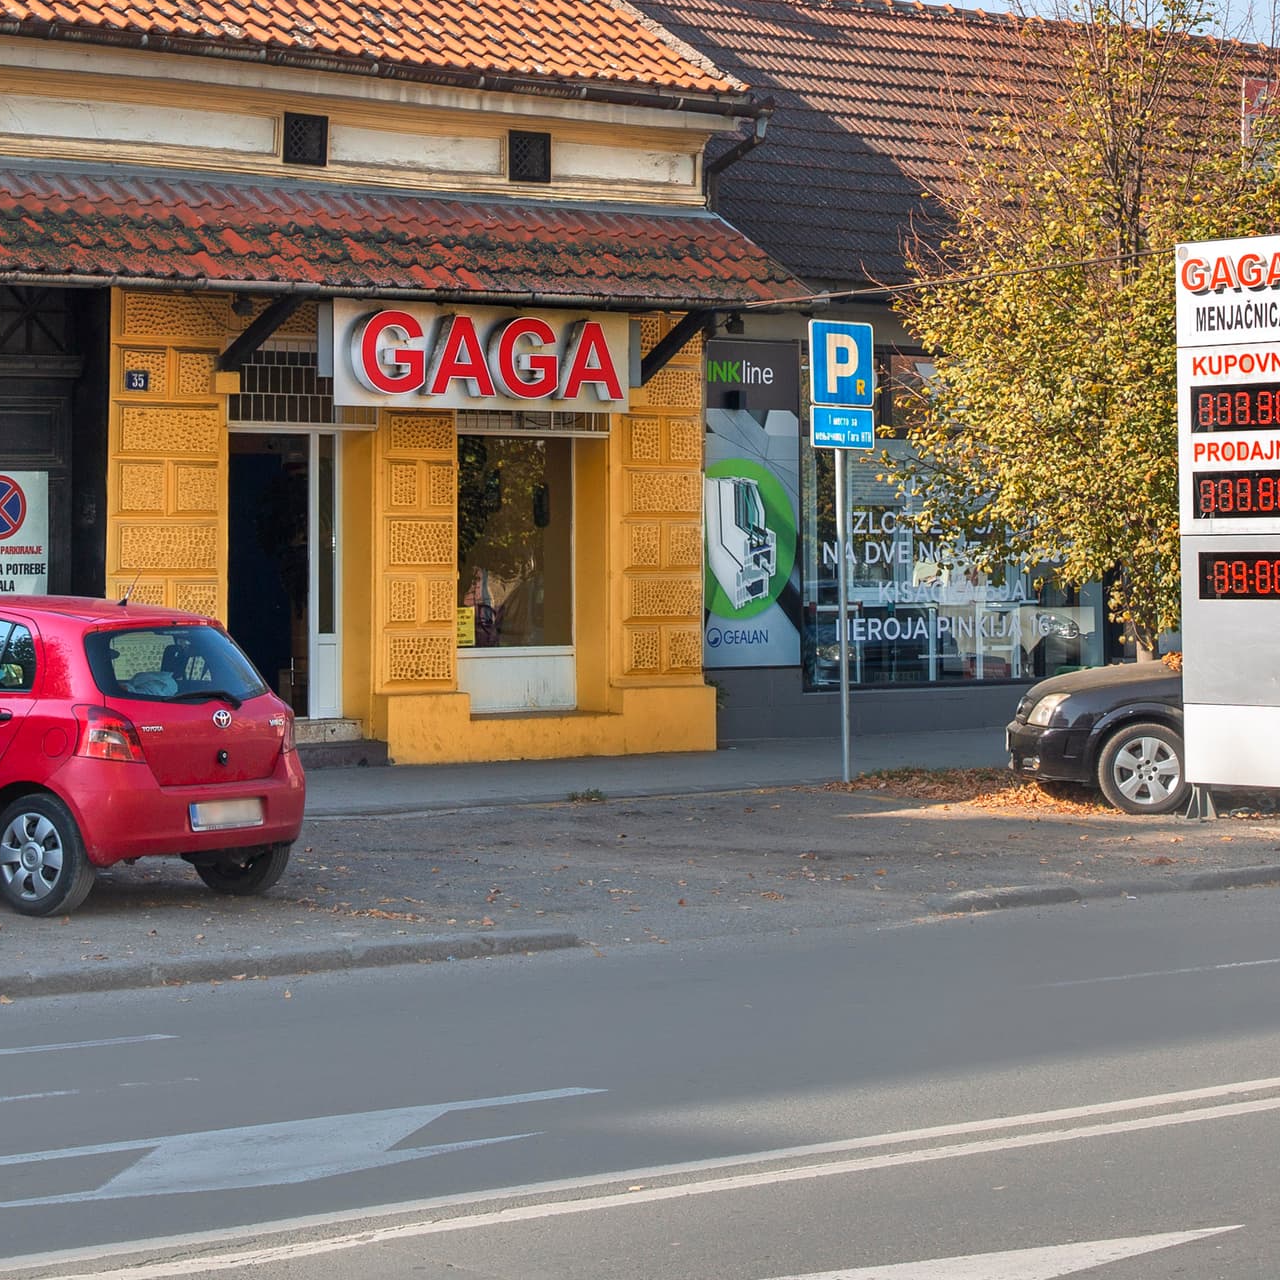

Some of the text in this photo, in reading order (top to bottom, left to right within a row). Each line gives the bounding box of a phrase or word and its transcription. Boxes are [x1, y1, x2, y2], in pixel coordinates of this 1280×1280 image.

[356, 309, 624, 401] GAGA
[826, 332, 859, 394] P
[132, 373, 145, 388] 35
[707, 359, 774, 385] INKline
[856, 379, 866, 396] R
[0, 545, 42, 555] PARKIRANJE
[865, 541, 912, 564] DVE
[6, 563, 46, 575] POTREBE
[723, 629, 769, 645] GEALAN
[937, 615, 1023, 640] PINKIJA
